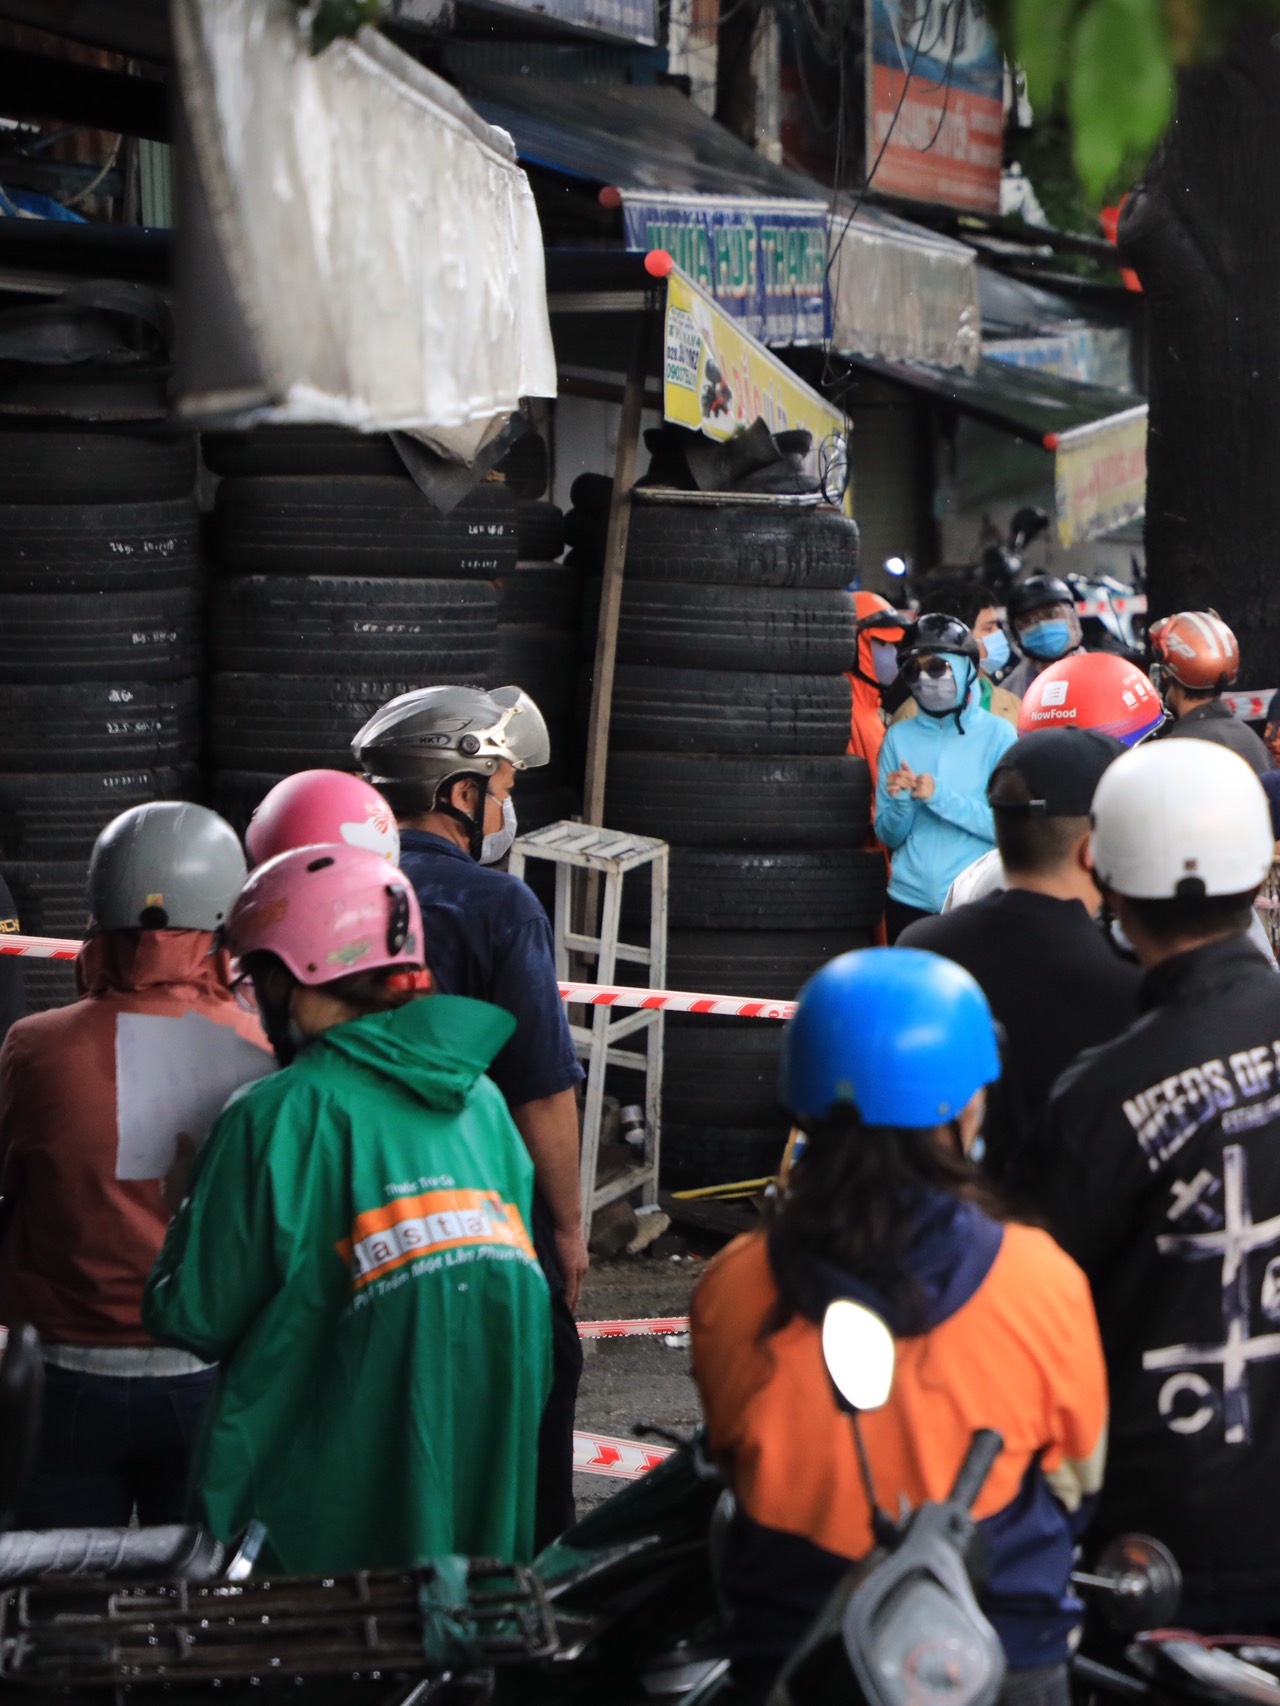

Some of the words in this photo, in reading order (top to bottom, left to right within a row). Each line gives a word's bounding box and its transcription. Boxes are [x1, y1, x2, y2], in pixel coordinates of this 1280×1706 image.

[1031, 707, 1077, 721] NowFood
[419, 736, 442, 745] HKT
[1122, 1059, 1236, 1172] NEEDS
[1229, 1046, 1275, 1098] OF
[353, 1213, 485, 1272] asta
